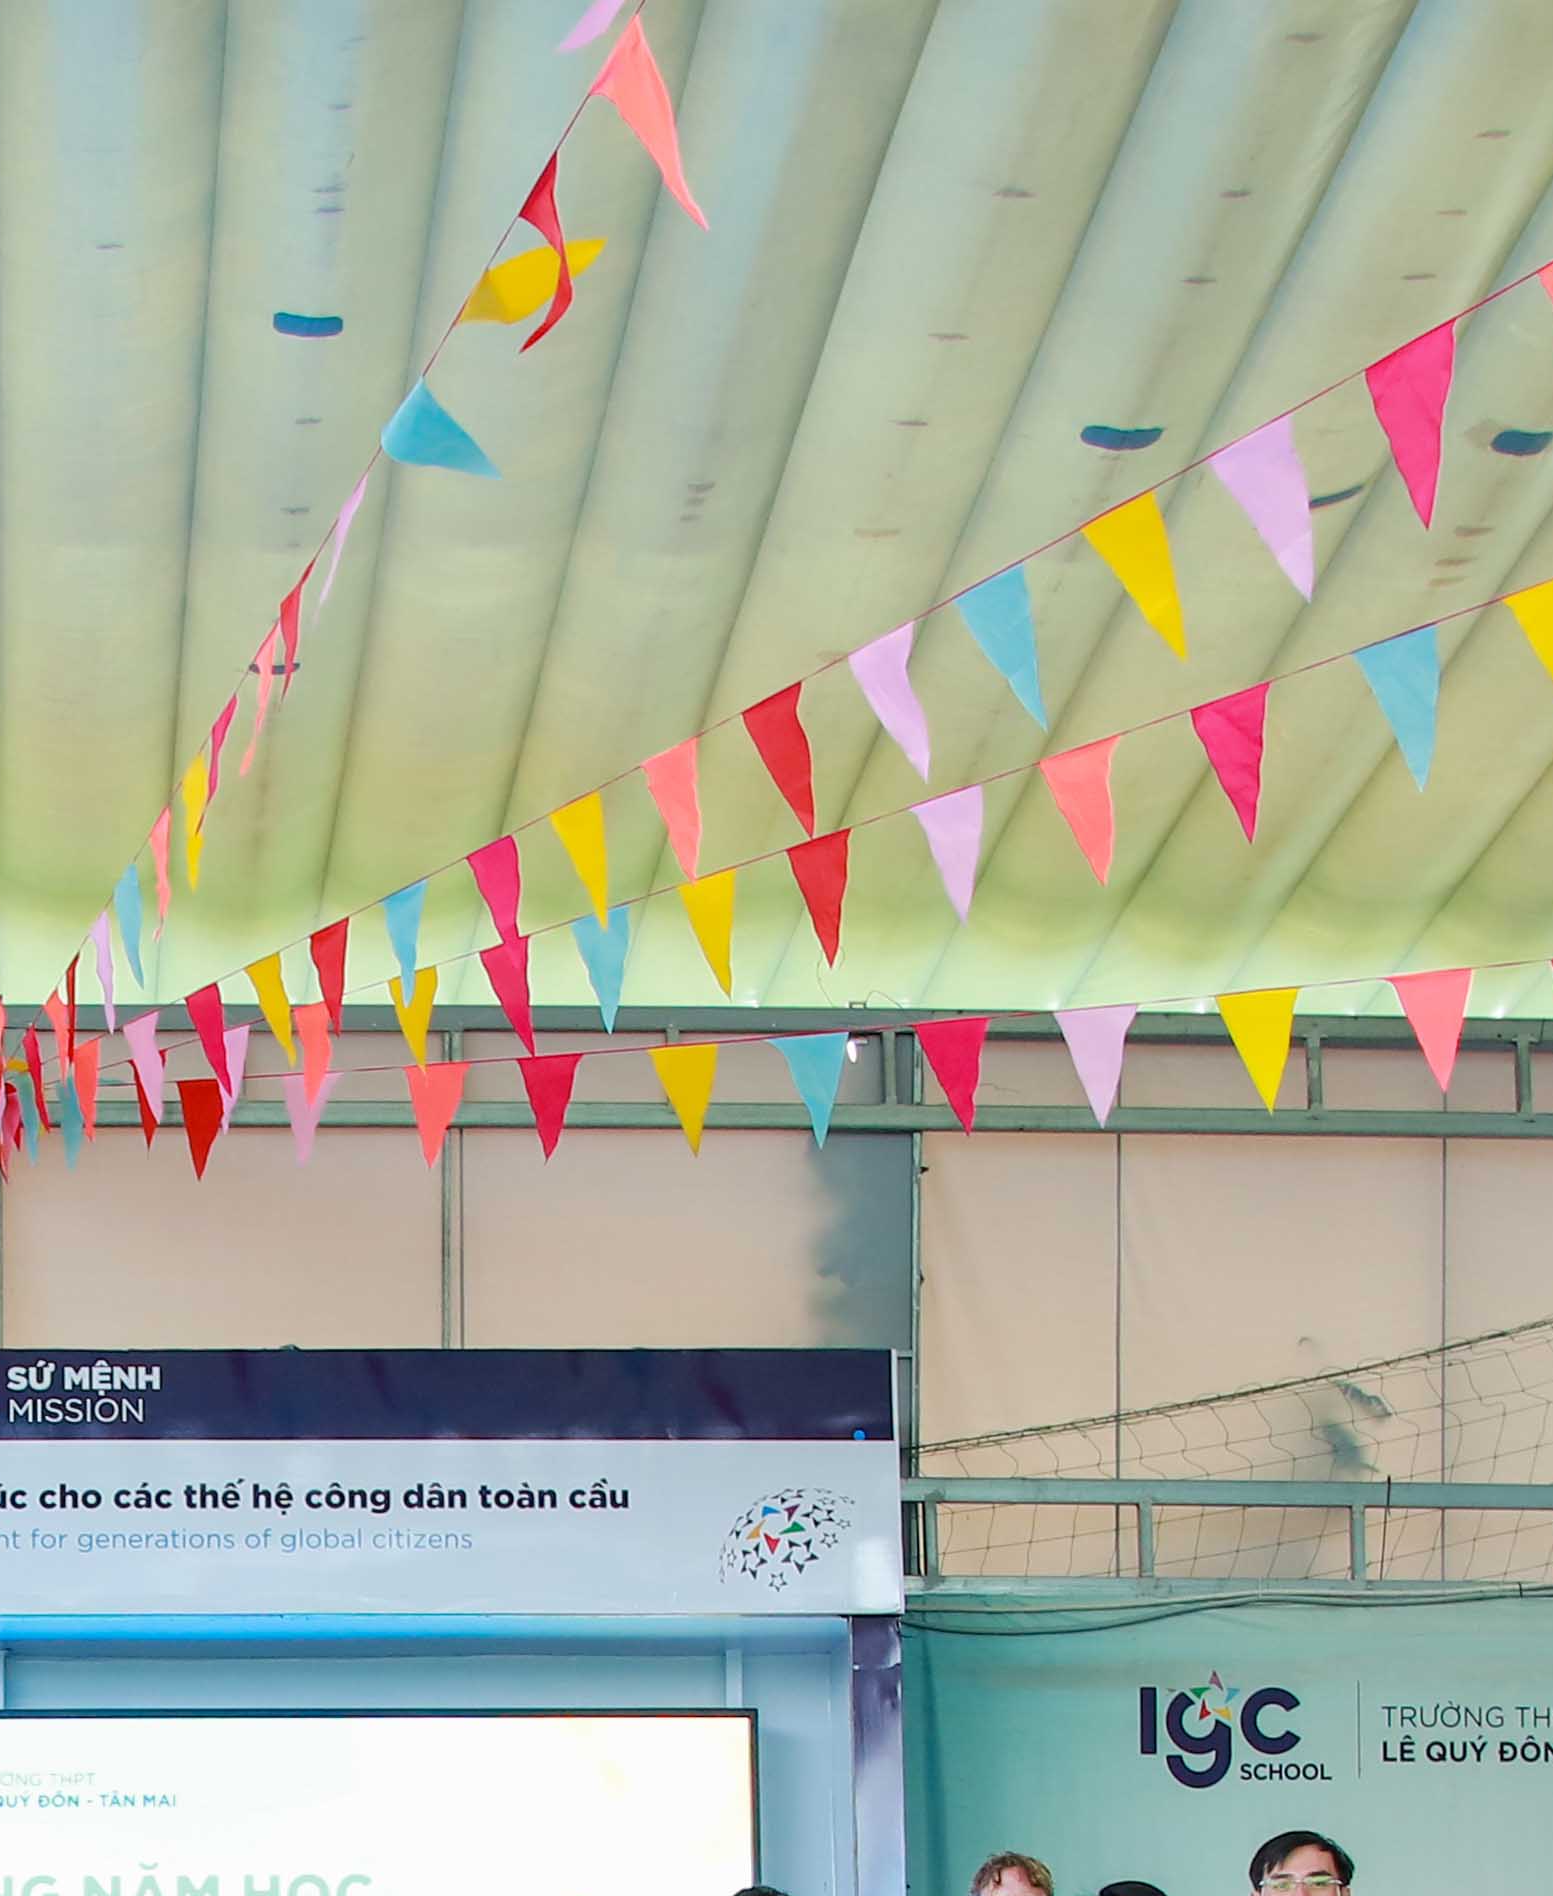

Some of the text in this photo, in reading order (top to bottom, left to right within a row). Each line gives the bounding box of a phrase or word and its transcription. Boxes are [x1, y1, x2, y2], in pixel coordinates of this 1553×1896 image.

[6, 1360, 160, 1398] SỨ MỆNH
[8, 1399, 144, 1423] MISSION
[39, 1484, 102, 1510] cho
[114, 1483, 172, 1510] các
[183, 1478, 242, 1510] thế
[253, 1484, 294, 1513] hệ
[304, 1484, 390, 1514] công
[403, 1483, 466, 1509] dân
[479, 1483, 557, 1509] toàn
[568, 1477, 629, 1509] cầu
[31, 1529, 67, 1550] for
[77, 1529, 235, 1554] generations
[245, 1528, 272, 1550] of
[280, 1528, 362, 1553] global
[372, 1528, 472, 1550] citizens
[1382, 1701, 1504, 1729] TRƯỜNG
[1382, 1736, 1413, 1763] LÊ
[1426, 1735, 1488, 1767] QUÝ
[50, 1773, 96, 1786] THPT
[1240, 1763, 1332, 1781] SCHOOL
[38, 1792, 80, 1808] ĐÔN
[99, 1791, 136, 1808] TÂN
[143, 1794, 177, 1807] MAI
